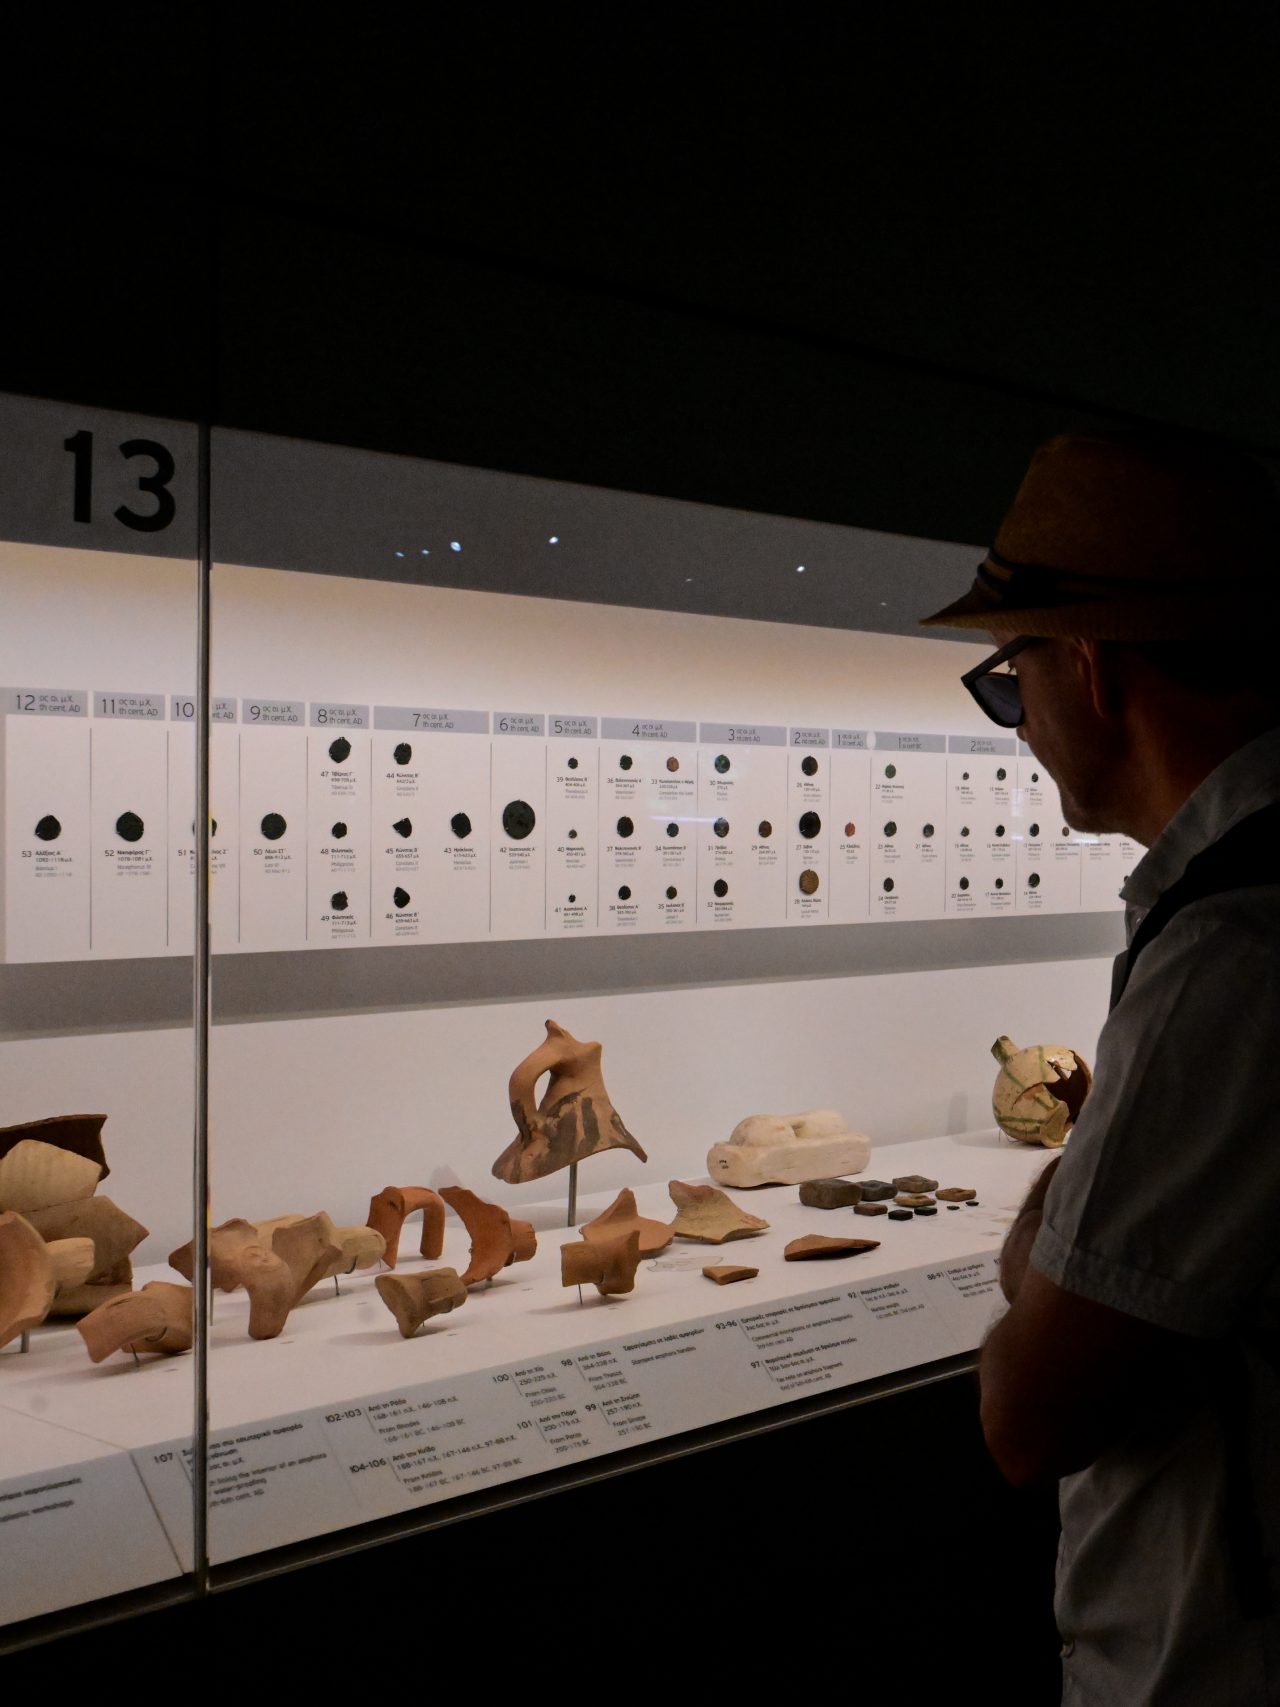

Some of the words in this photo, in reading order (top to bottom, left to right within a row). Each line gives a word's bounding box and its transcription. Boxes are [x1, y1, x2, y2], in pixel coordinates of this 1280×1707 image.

[64, 430, 176, 533] 13
[16, 694, 36, 711] 12
[102, 698, 115, 714] 11
[175, 702, 195, 718] 10
[250, 705, 261, 721] 9
[317, 708, 328, 724] 8
[412, 713, 421, 728] 7
[499, 717, 509, 732] 6
[554, 720, 563, 734] 5
[631, 724, 640, 737] 4
[728, 728, 735, 742] 3
[794, 731, 801, 744] 2
[837, 734, 841, 746] 1
[969, 740, 977, 753] 2
[21, 850, 32, 858] 53
[104, 849, 115, 857] 52
[177, 849, 187, 857] 51
[253, 848, 263, 856] 50
[320, 848, 329, 856] 48
[715, 1320, 738, 1331] 93-96
[561, 1358, 573, 1367] 98
[750, 1361, 760, 1370] 97
[492, 1373, 509, 1384] 100
[585, 1403, 597, 1412] 99
[324, 1409, 362, 1423] 102-103
[516, 1420, 532, 1431] 101
[153, 1452, 173, 1464] 107
[349, 1457, 387, 1474] 104-106
